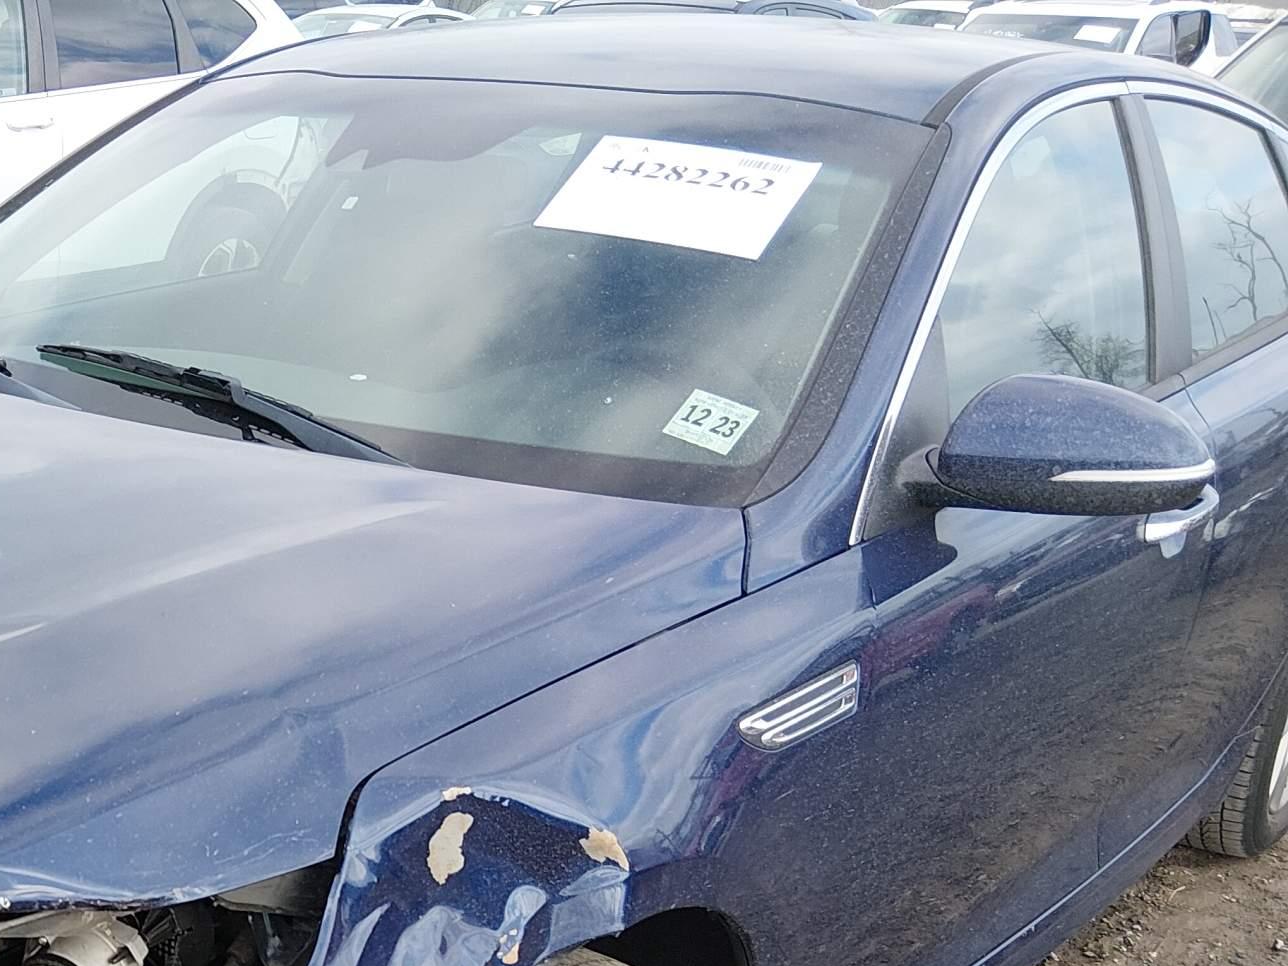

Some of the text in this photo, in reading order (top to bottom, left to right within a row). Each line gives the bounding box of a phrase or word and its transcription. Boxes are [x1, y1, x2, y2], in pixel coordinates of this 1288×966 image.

[602, 157, 776, 195] 44282262
[680, 405, 740, 437] 12 23
